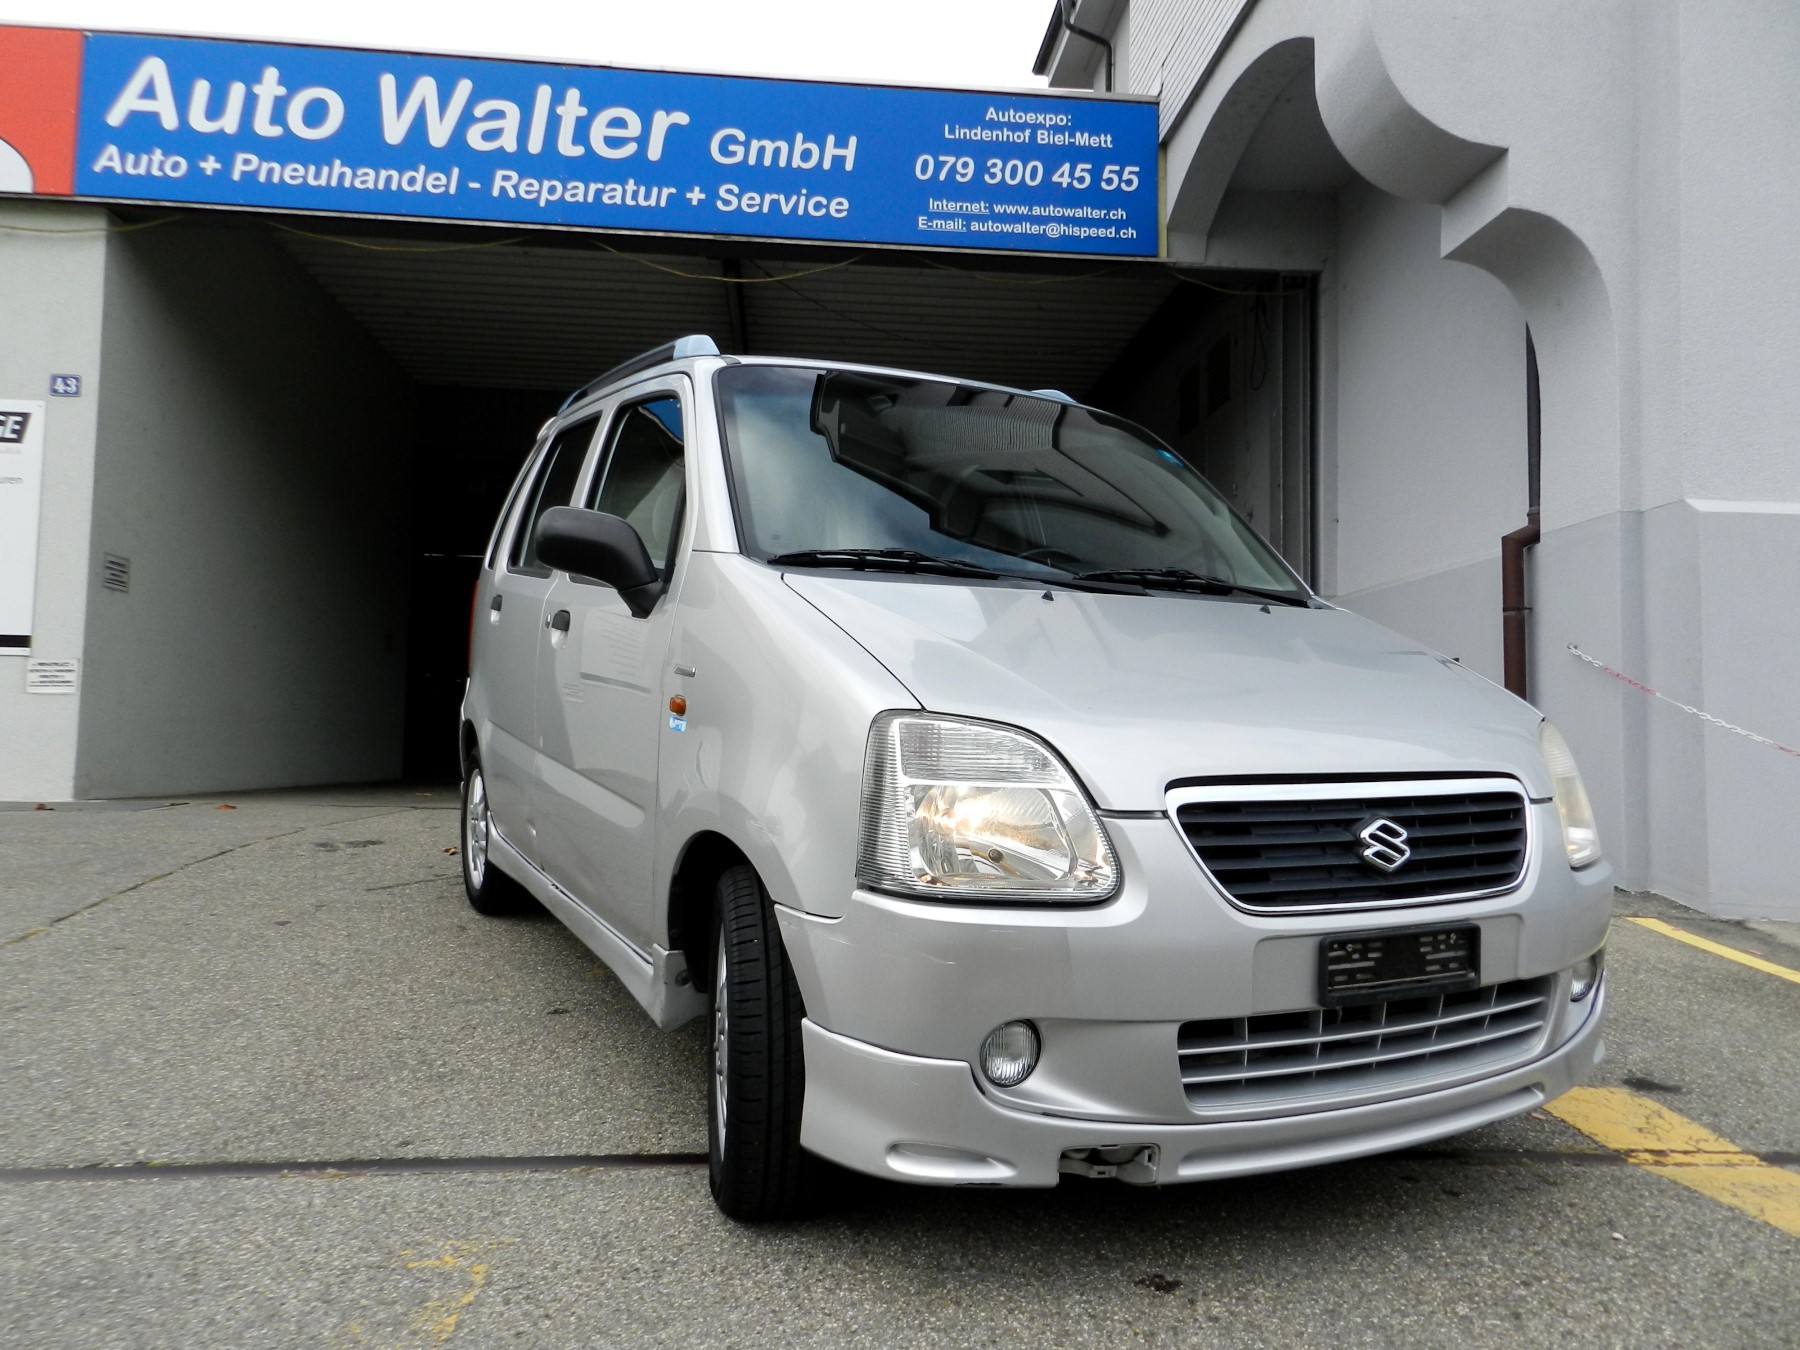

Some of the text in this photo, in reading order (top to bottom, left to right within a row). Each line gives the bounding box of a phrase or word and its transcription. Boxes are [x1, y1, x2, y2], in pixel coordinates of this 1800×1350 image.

[106, 55, 858, 173] Auto Walter GmbH
[985, 107, 1073, 128] Autoexpo:
[944, 124, 1114, 149] Lindenhof Biel-Mett
[92, 144, 188, 179] Auto
[231, 152, 460, 196] Pneuhandel
[491, 169, 677, 209] Reparatur
[716, 183, 849, 218] Service
[914, 154, 1140, 192] 079 300 45 55
[929, 198, 1127, 221] Internet: www.autowalter.ch
[918, 216, 1138, 240] E-mail: autowalter@hispeed.ch
[54, 377, 78, 394] 43
